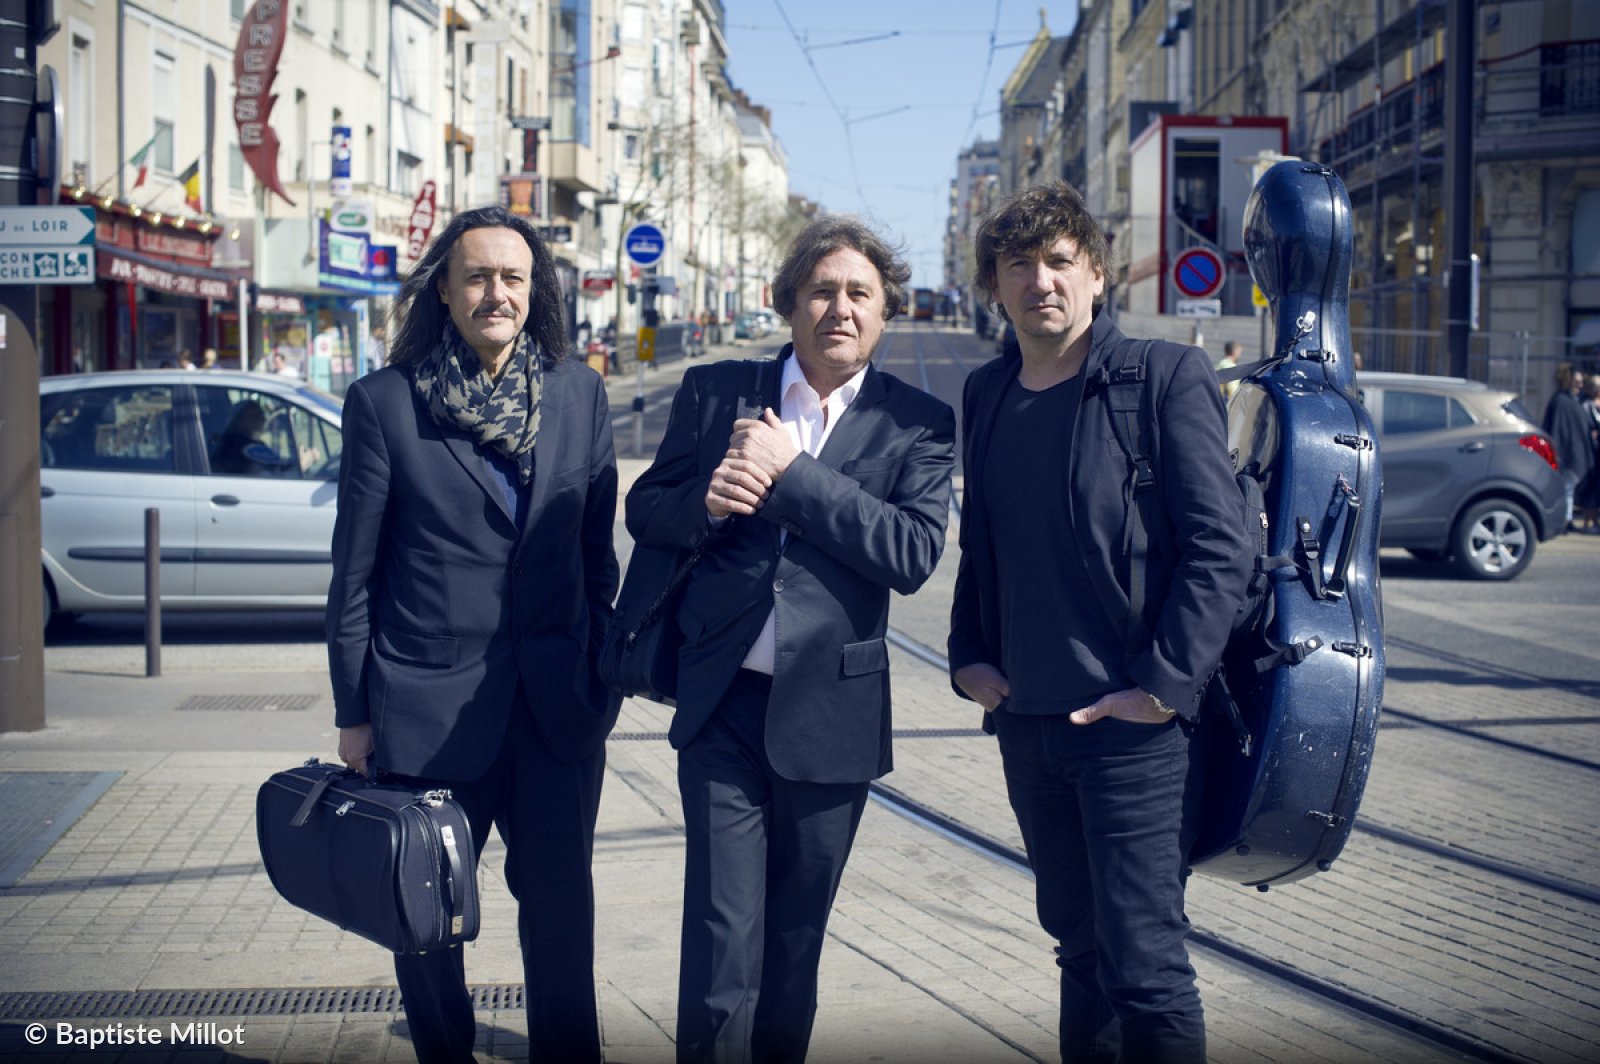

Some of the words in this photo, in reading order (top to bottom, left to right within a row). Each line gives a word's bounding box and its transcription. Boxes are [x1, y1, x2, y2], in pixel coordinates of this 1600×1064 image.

[235, 0, 281, 146] PRESSE
[32, 220, 68, 232] LOIR
[408, 183, 436, 257] TABAC
[0, 252, 30, 265] CON
[0, 267, 31, 279] CHE
